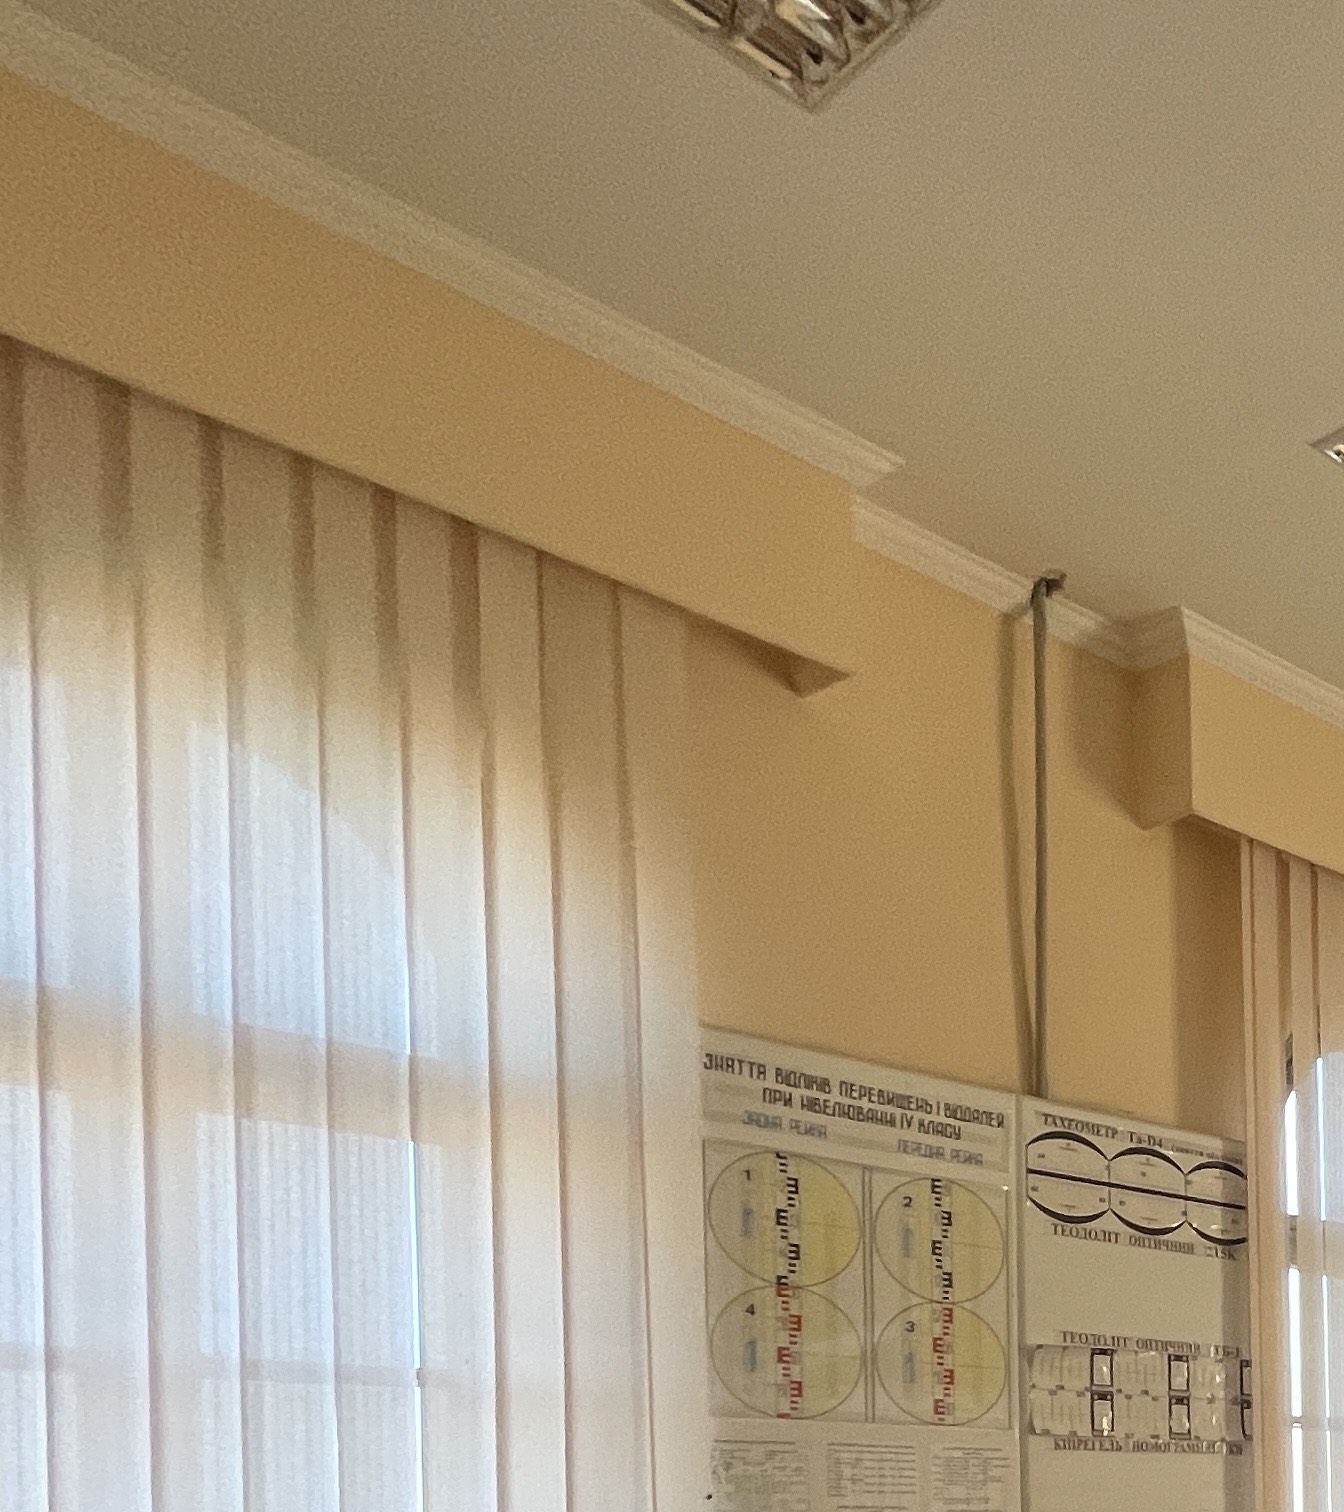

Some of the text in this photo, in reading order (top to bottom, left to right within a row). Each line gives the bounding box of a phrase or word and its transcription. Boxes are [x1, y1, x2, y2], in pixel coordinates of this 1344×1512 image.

[703, 1052, 767, 1081] ЗНЯТТЯ
[762, 1086, 793, 1109] ПРИ
[917, 1117, 962, 1140] КЛАСУ
[1042, 1113, 1118, 1140] ТАХЕОМЕТР
[903, 1196, 912, 1208] 2
[745, 1303, 755, 1316] 4
[905, 1320, 915, 1333] 3
